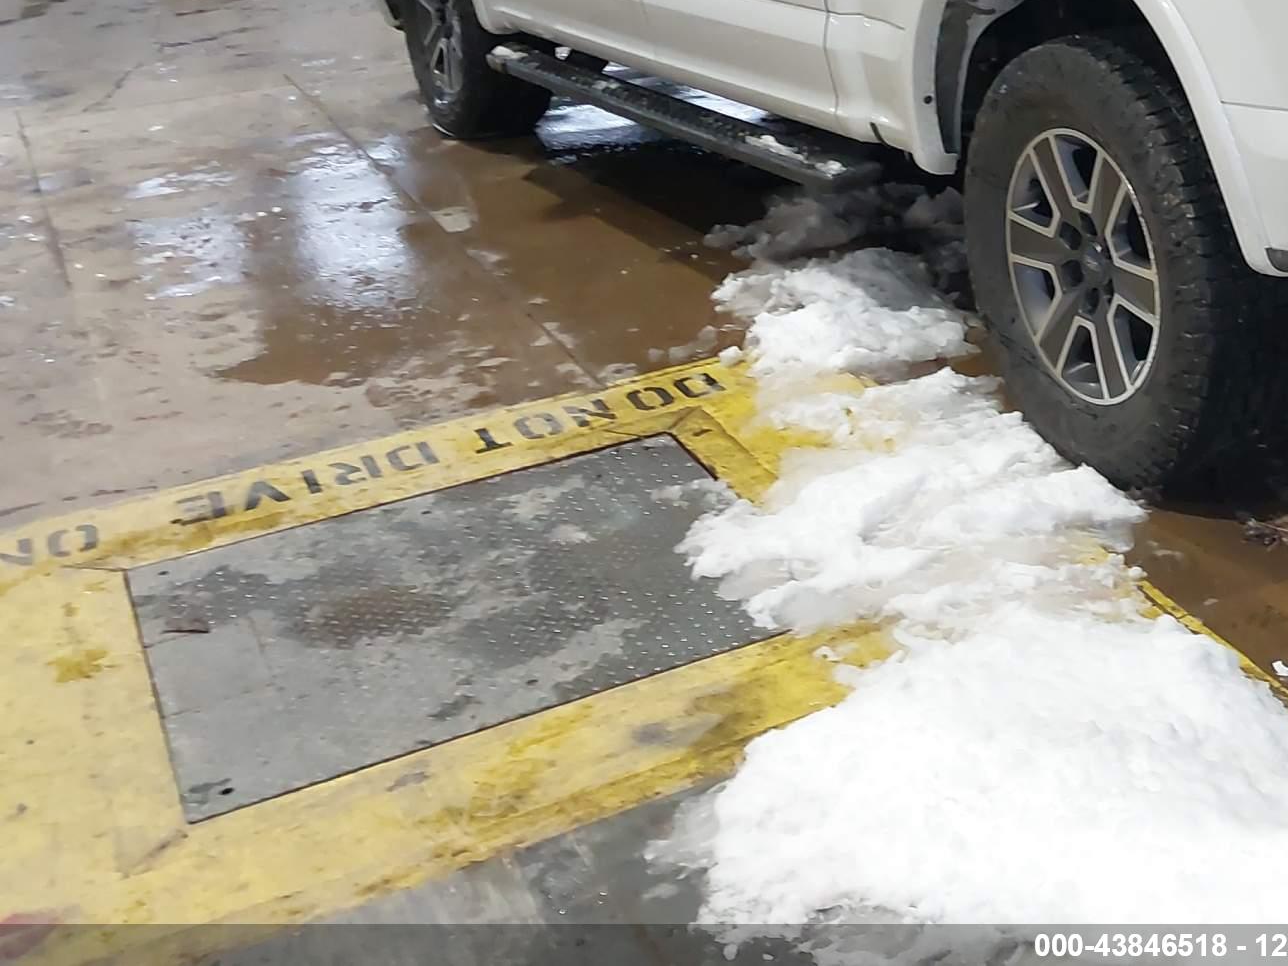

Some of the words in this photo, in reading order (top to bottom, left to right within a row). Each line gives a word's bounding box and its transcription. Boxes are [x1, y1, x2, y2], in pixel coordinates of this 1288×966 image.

[627, 372, 727, 413] DO
[474, 397, 618, 455] NOT
[173, 439, 438, 525] DRIVE
